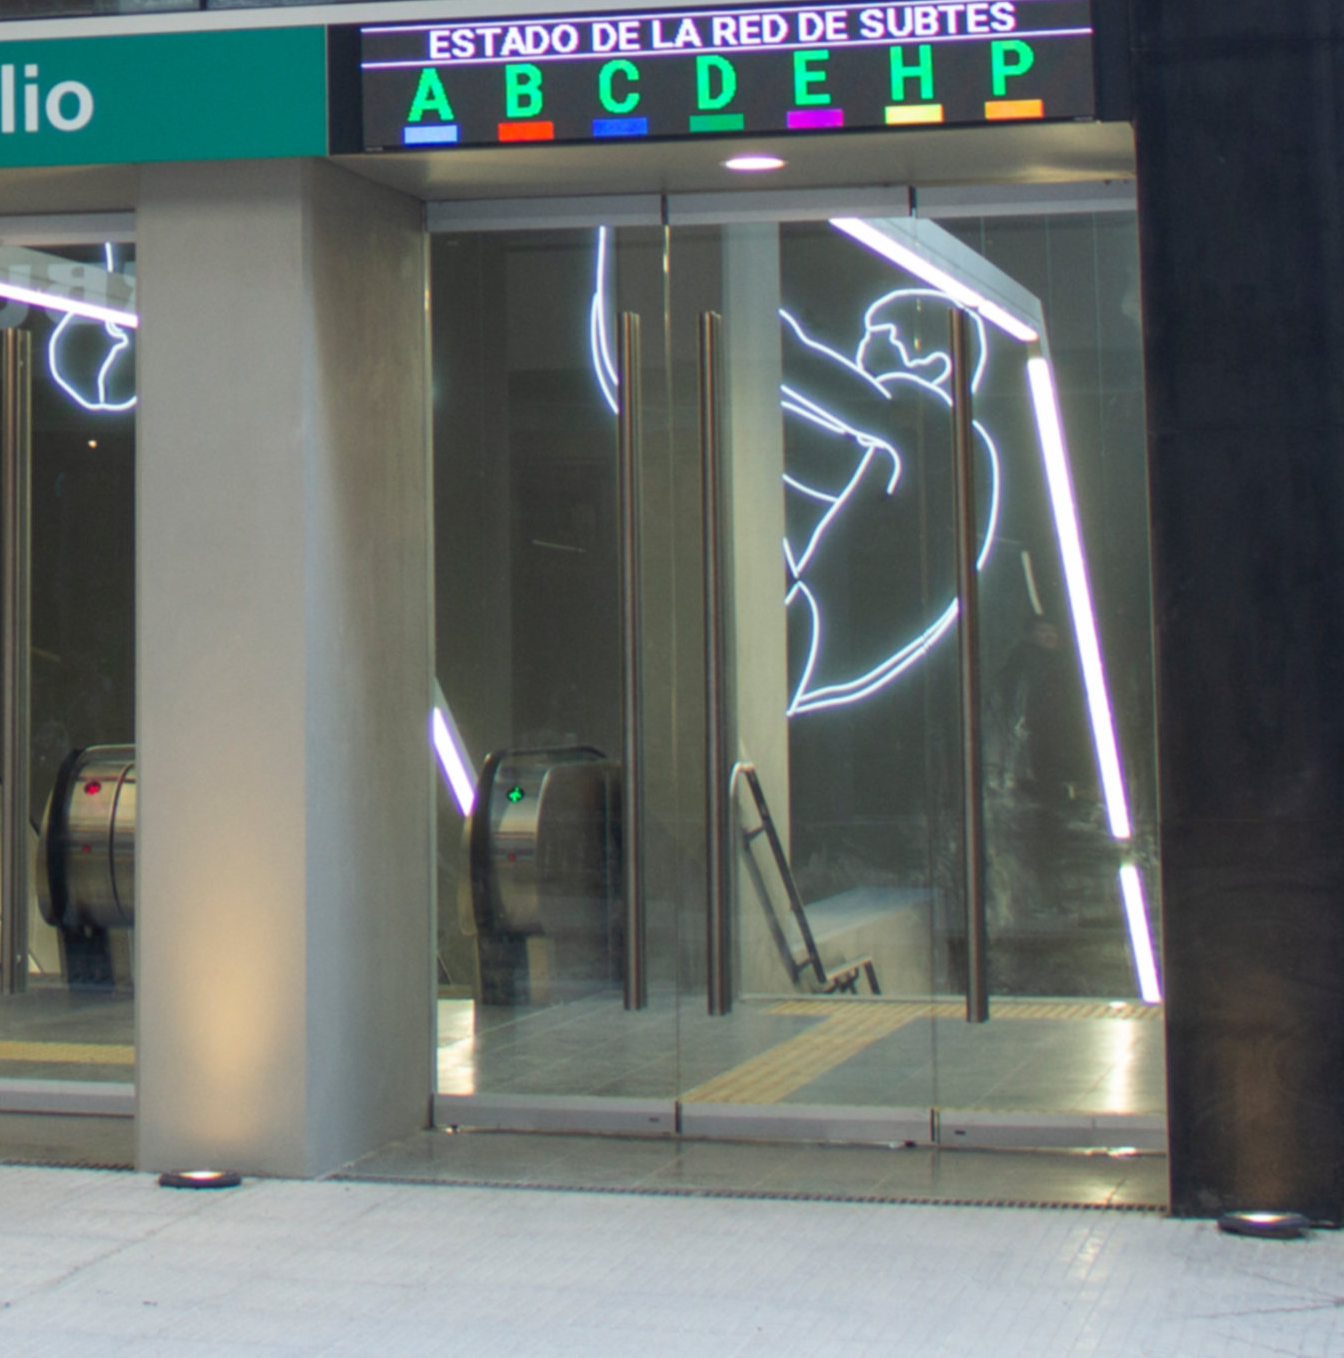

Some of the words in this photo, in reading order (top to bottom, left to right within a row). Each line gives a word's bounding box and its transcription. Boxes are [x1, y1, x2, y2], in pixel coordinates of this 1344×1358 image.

[428, 23, 580, 60] ESTADO
[591, 20, 642, 53] DE
[651, 17, 703, 49] LA
[711, 13, 789, 46] RED
[798, 10, 850, 42] DE
[860, 1, 1017, 38] SUBTES
[407, 67, 455, 122] A
[505, 63, 543, 118] B
[599, 59, 640, 113] C
[696, 54, 737, 110] D
[793, 49, 831, 105] E
[889, 44, 935, 101] H
[990, 39, 1035, 96] P
